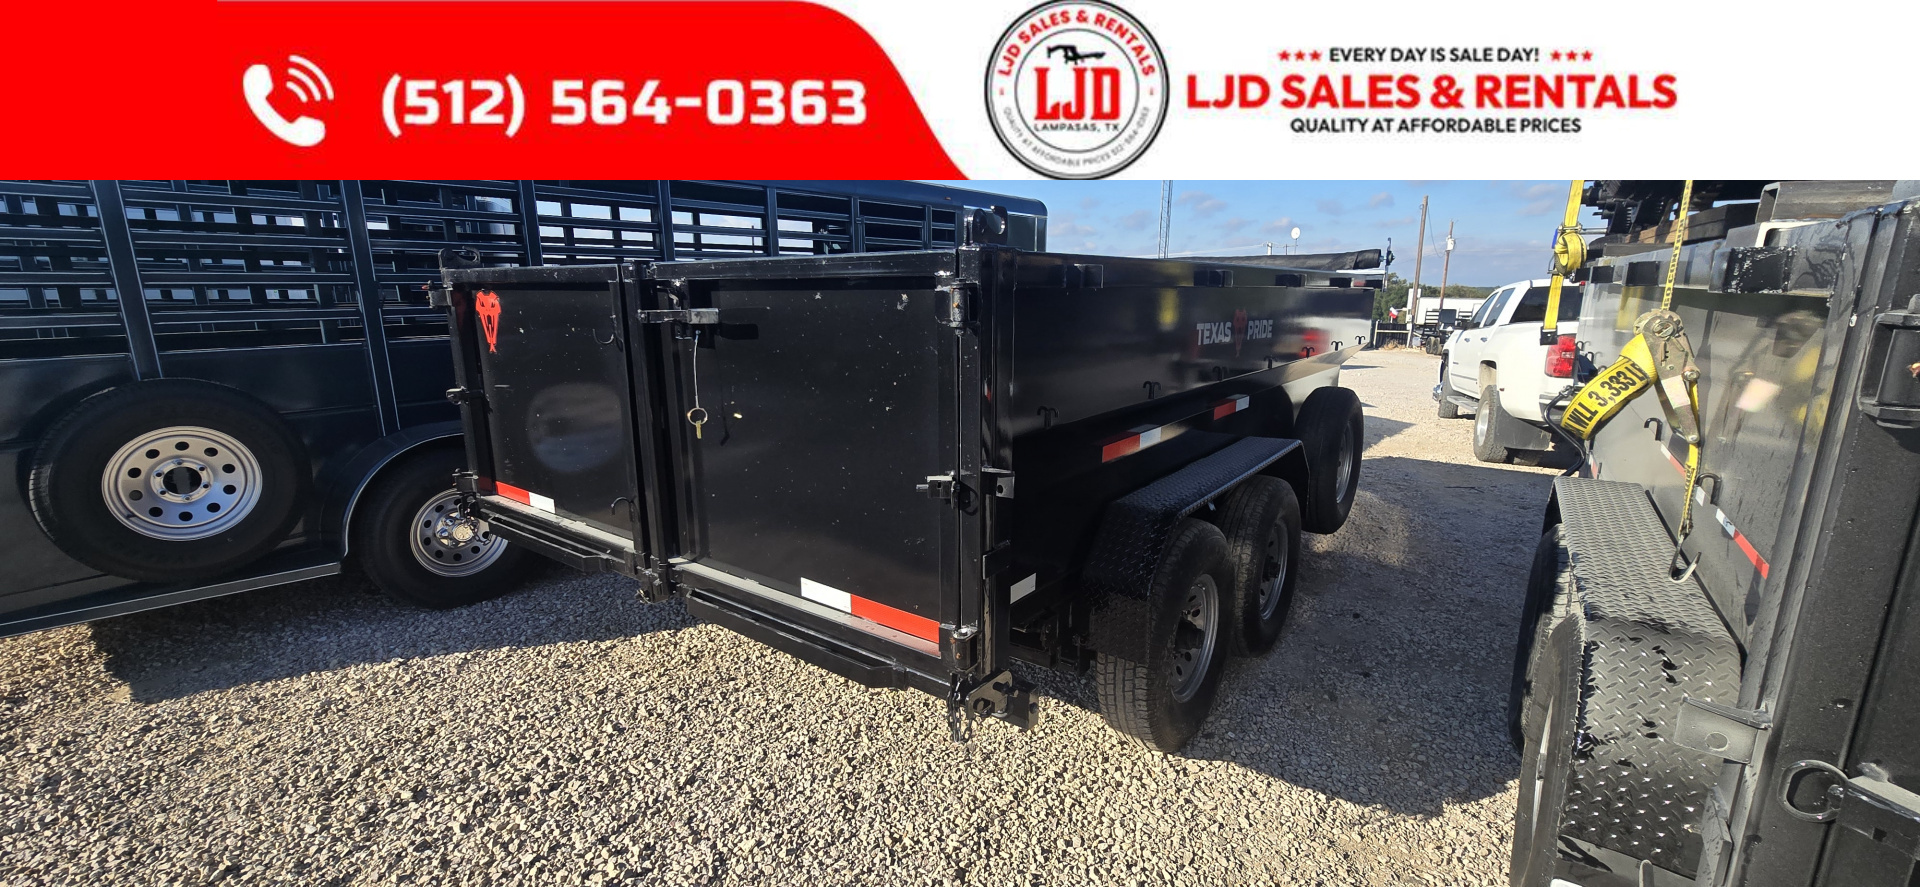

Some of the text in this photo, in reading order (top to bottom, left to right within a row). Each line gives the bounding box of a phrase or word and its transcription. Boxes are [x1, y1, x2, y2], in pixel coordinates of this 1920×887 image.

[1197, 319, 1274, 346] TEXAS PRIDE
[1567, 401, 1599, 429] WLL
[1588, 371, 1638, 408] 3,333
